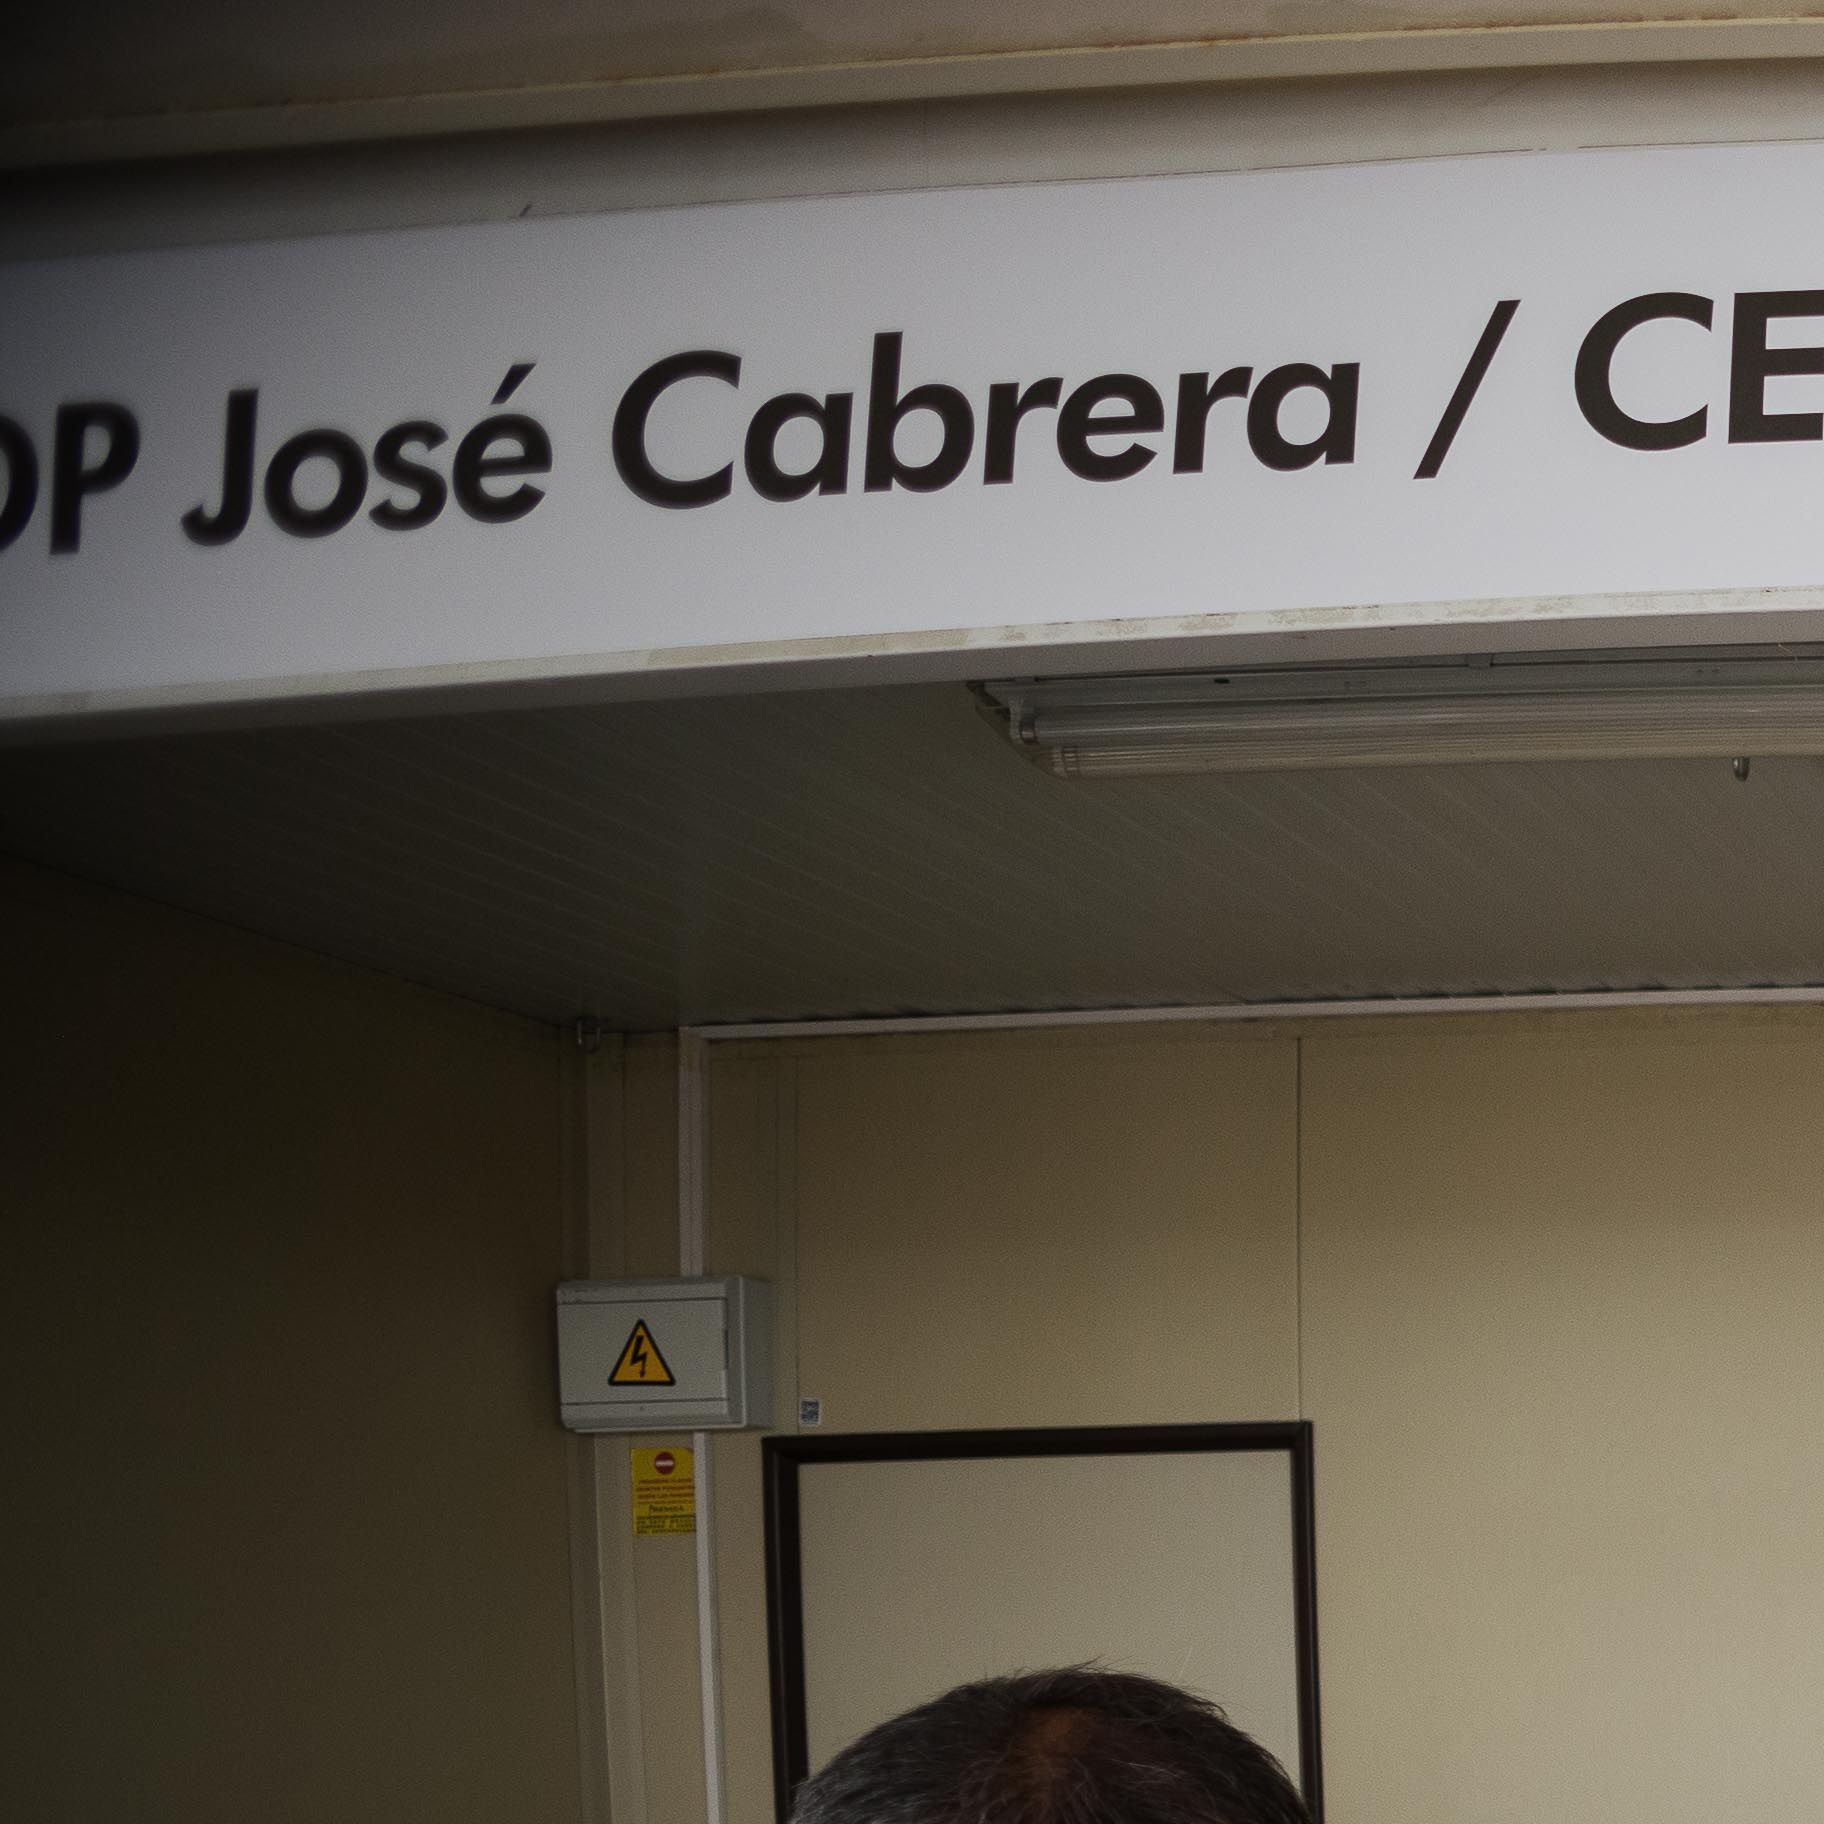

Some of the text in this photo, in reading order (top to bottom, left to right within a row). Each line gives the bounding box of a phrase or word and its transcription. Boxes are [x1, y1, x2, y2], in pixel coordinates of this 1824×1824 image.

[179, 361, 553, 548] José
[611, 331, 1360, 510] Cabrera
[1413, 299, 1521, 480] /
